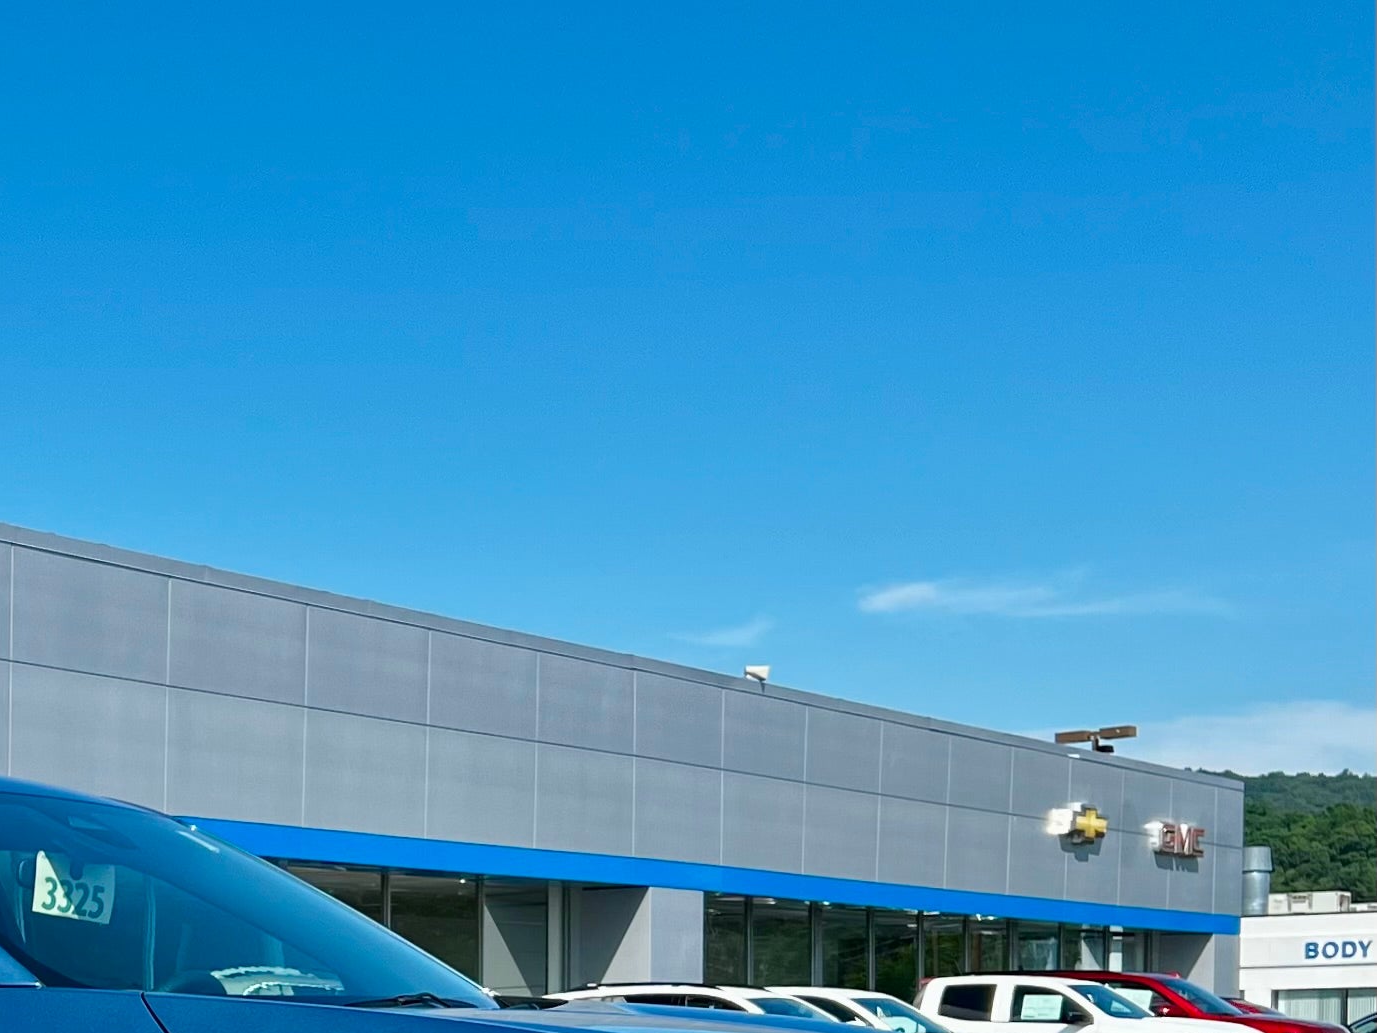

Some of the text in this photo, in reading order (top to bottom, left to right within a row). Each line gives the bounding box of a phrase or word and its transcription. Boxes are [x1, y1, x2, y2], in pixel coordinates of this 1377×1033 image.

[1162, 823, 1205, 857] GMC
[41, 876, 106, 920] 3325
[1304, 940, 1373, 959] BODY
